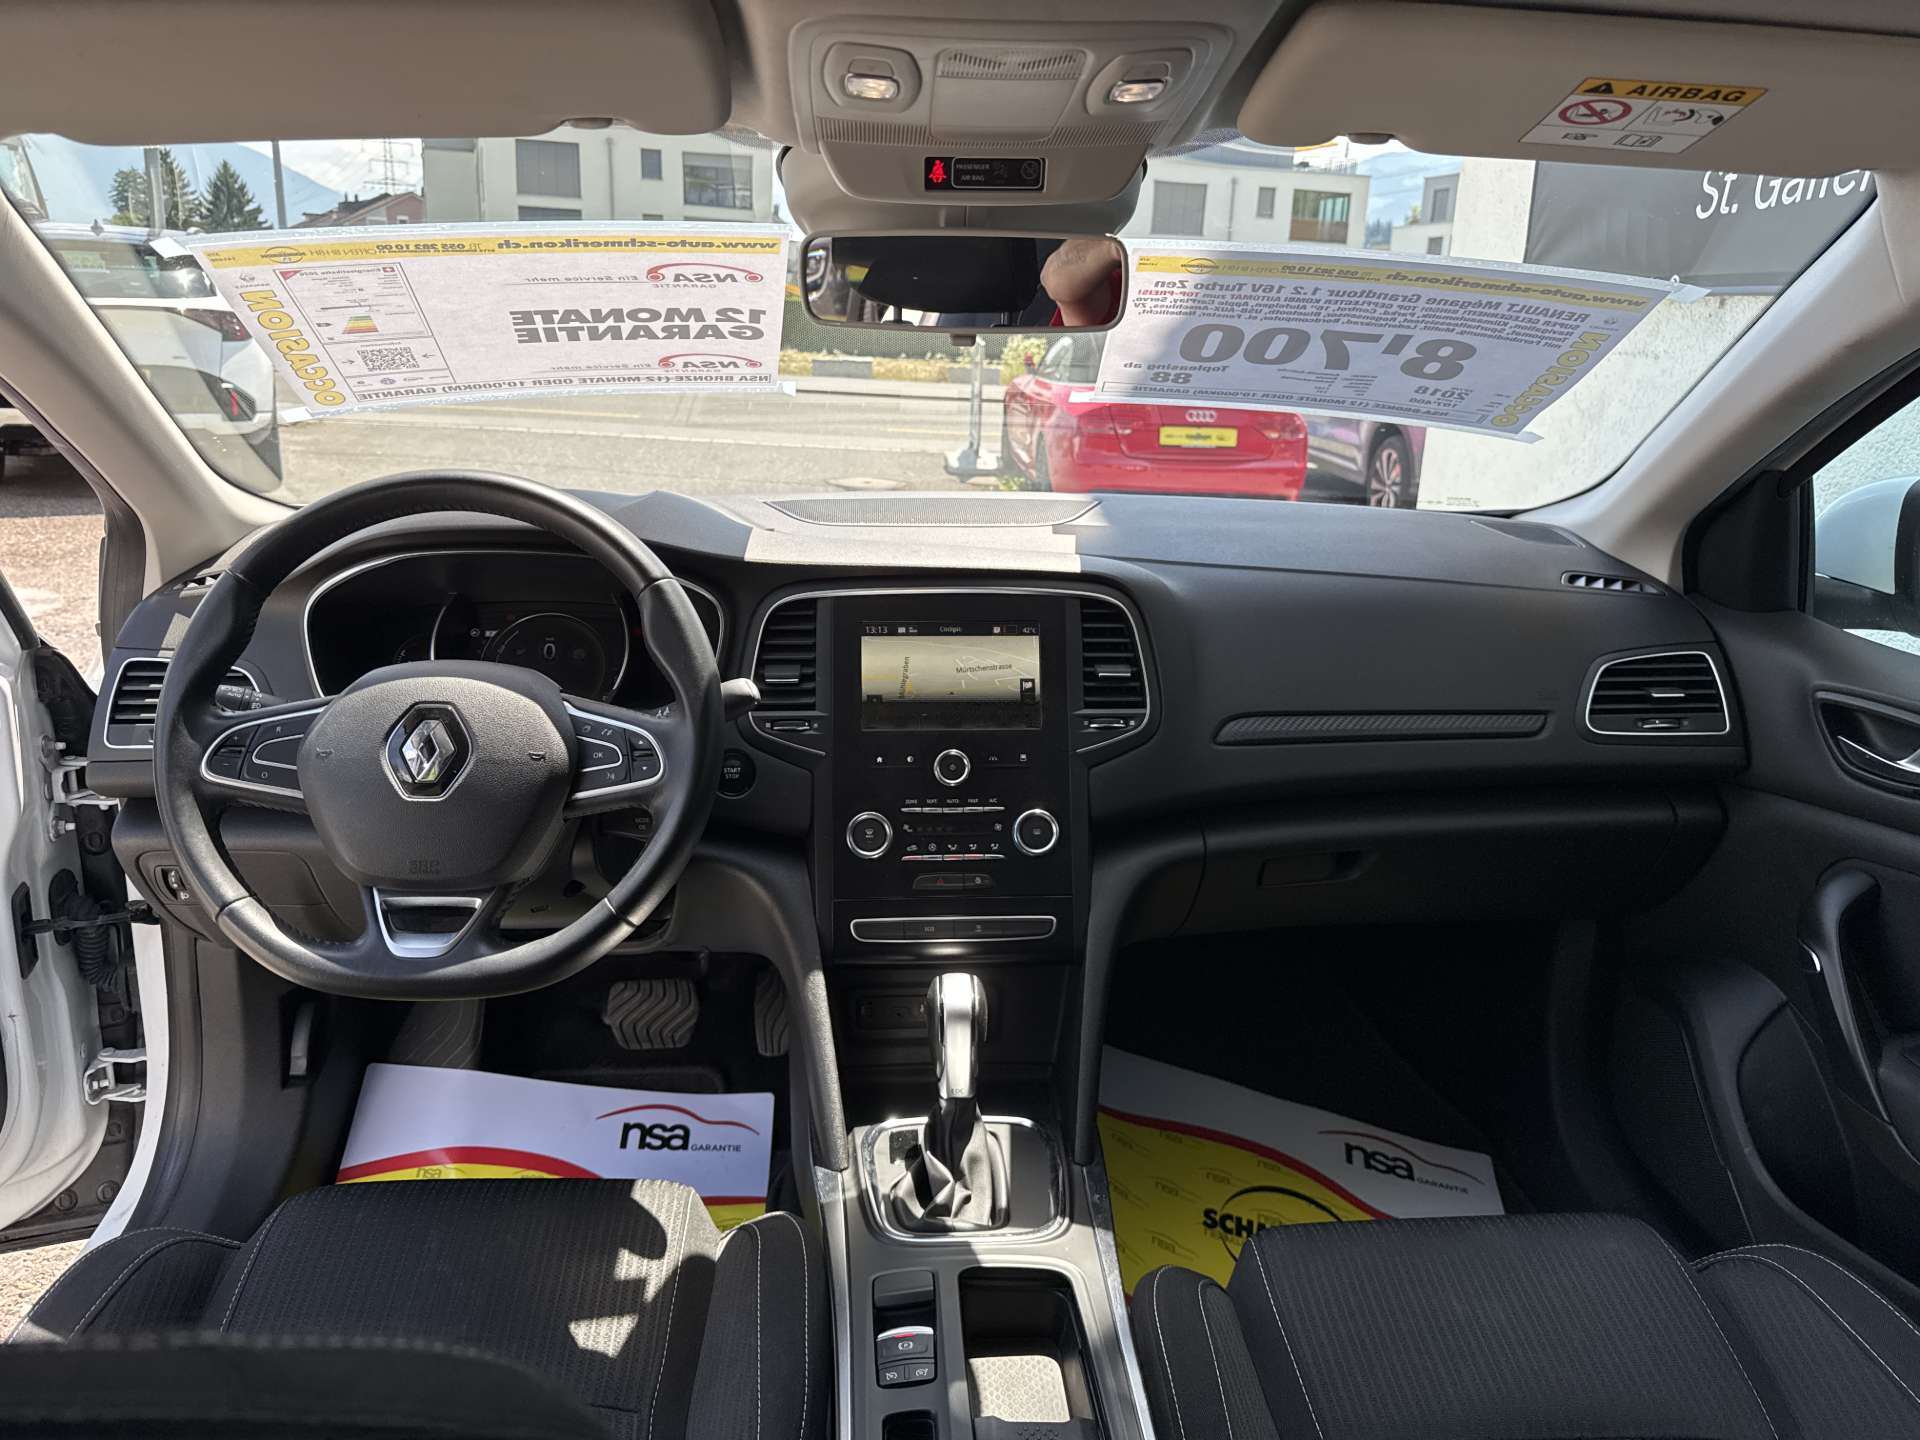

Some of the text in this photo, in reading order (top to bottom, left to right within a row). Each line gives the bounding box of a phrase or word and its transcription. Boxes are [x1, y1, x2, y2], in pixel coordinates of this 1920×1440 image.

[1625, 84, 1747, 103] AIRBAG
[1695, 170, 1738, 220] St.
[865, 626, 888, 635] 13:13
[543, 642, 556, 660] 0
[620, 1121, 742, 1153] nsa GARANTIE
[415, 1166, 443, 1179] nsa
[1344, 1141, 1470, 1194] nsa GARANTIE
